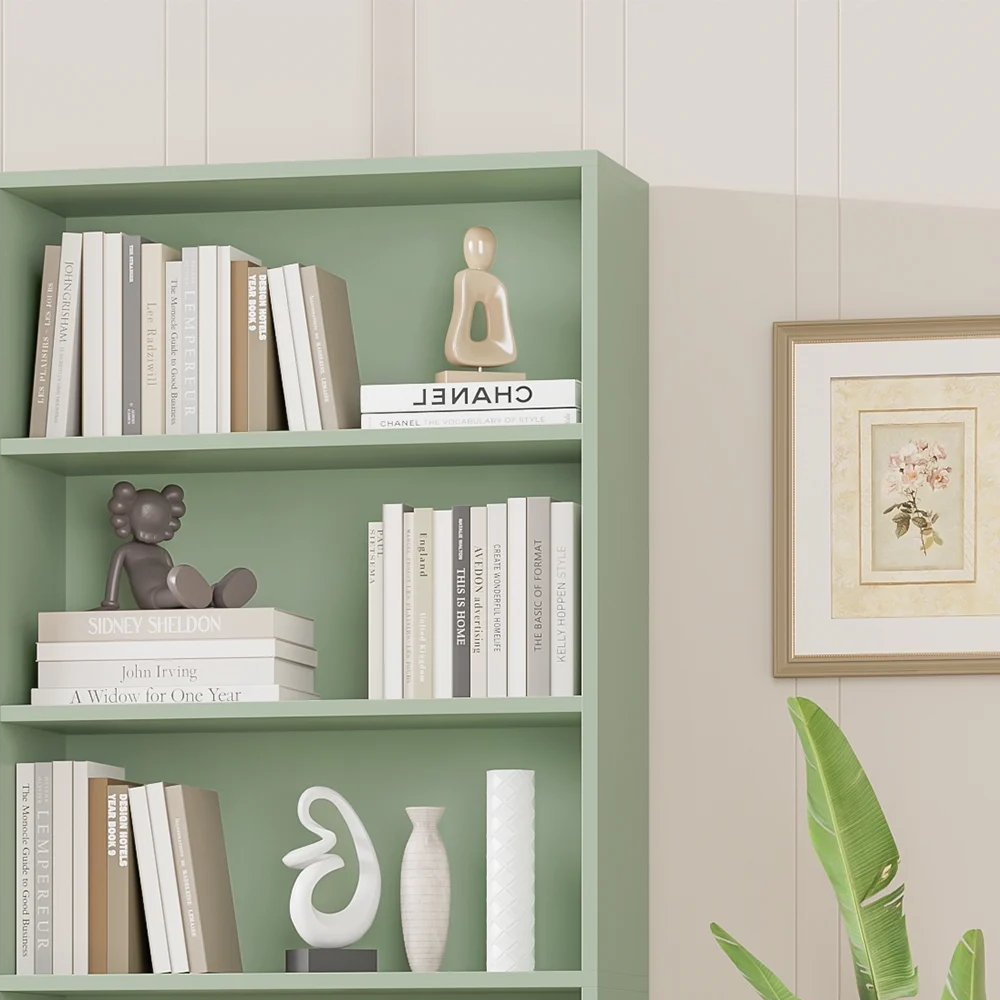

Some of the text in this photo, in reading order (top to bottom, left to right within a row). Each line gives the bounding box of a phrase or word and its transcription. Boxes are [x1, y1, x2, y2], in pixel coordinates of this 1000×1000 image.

[147, 302, 157, 386] Lee Radziwill
[259, 274, 267, 340] DESIGN HOTELS
[170, 279, 178, 425] The Monocle Guide to Good Business
[380, 418, 420, 427] CHANEL
[518, 415, 546, 423] STYLE
[417, 532, 428, 577] England
[88, 615, 221, 635] SIDNEY SHELDON
[456, 568, 466, 645] THIS IS HOME
[473, 546, 483, 654] AVEDON advertising
[493, 544, 501, 652] CREATE WONDERFUL HOMELIFE
[533, 539, 542, 652] THE BASIC OF FORMAT
[556, 545, 566, 663] KELLY HOPPEN STYLE
[69, 687, 241, 704] A Widow for One Year
[120, 665, 198, 683] John Irving
[108, 793, 117, 819] YEAR
[108, 821, 117, 847] BOOK
[119, 793, 128, 867] DESIGN HOTELS
[22, 783, 30, 957] The Monocle Guide to Good Business
